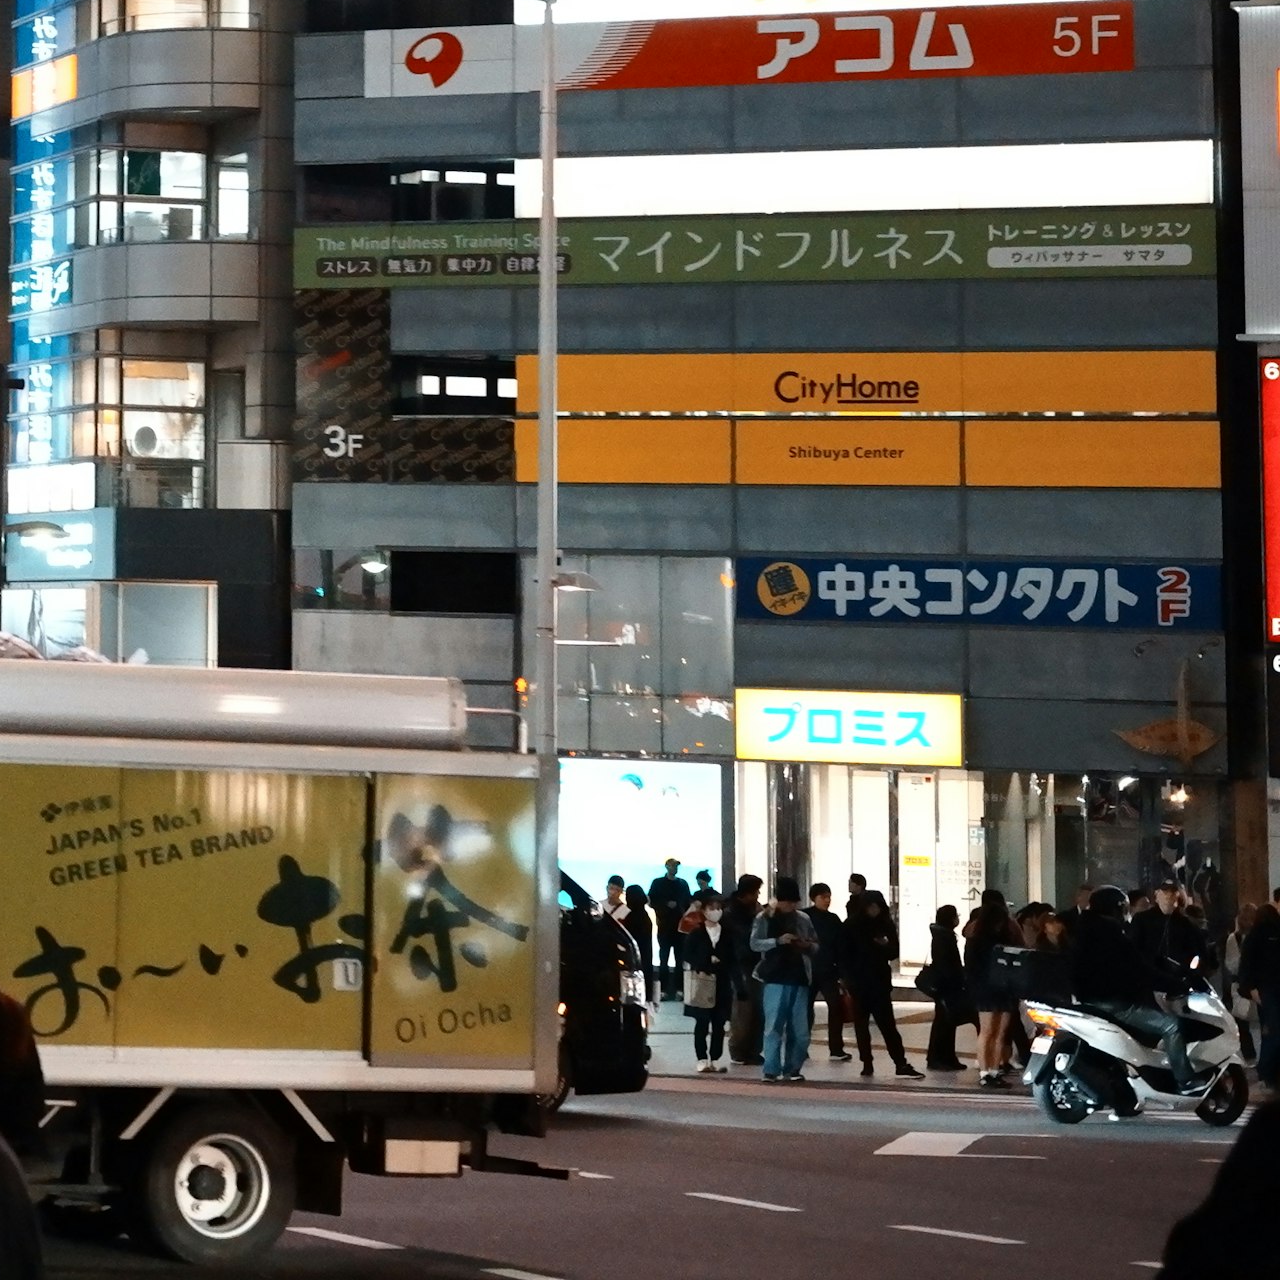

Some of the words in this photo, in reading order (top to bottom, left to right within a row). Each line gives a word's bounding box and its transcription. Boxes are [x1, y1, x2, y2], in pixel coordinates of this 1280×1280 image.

[756, 11, 975, 79] アコム
[1052, 14, 1122, 58] 5F
[316, 237, 346, 251] The
[351, 235, 448, 251] Mindfulness
[453, 233, 518, 250] Training
[592, 228, 965, 274] マインドフルネス
[322, 260, 373, 274] ストレス
[387, 257, 432, 273] 無気力
[447, 257, 492, 273] 集中力
[774, 371, 920, 404] CityHome
[323, 425, 364, 458] 3F
[788, 445, 850, 462] Shibuya
[853, 445, 905, 460] Center
[817, 562, 1138, 622] 中央コンタクト
[1156, 566, 1192, 626] 2F
[762, 701, 933, 748] プロミス
[46, 817, 145, 856] JAPAN'S
[152, 807, 203, 834] No.1
[48, 853, 129, 887] GREEN
[134, 843, 184, 869] TEA
[190, 824, 275, 858] BRAND
[395, 1013, 427, 1044] Oi
[438, 1001, 513, 1035] Ocha
